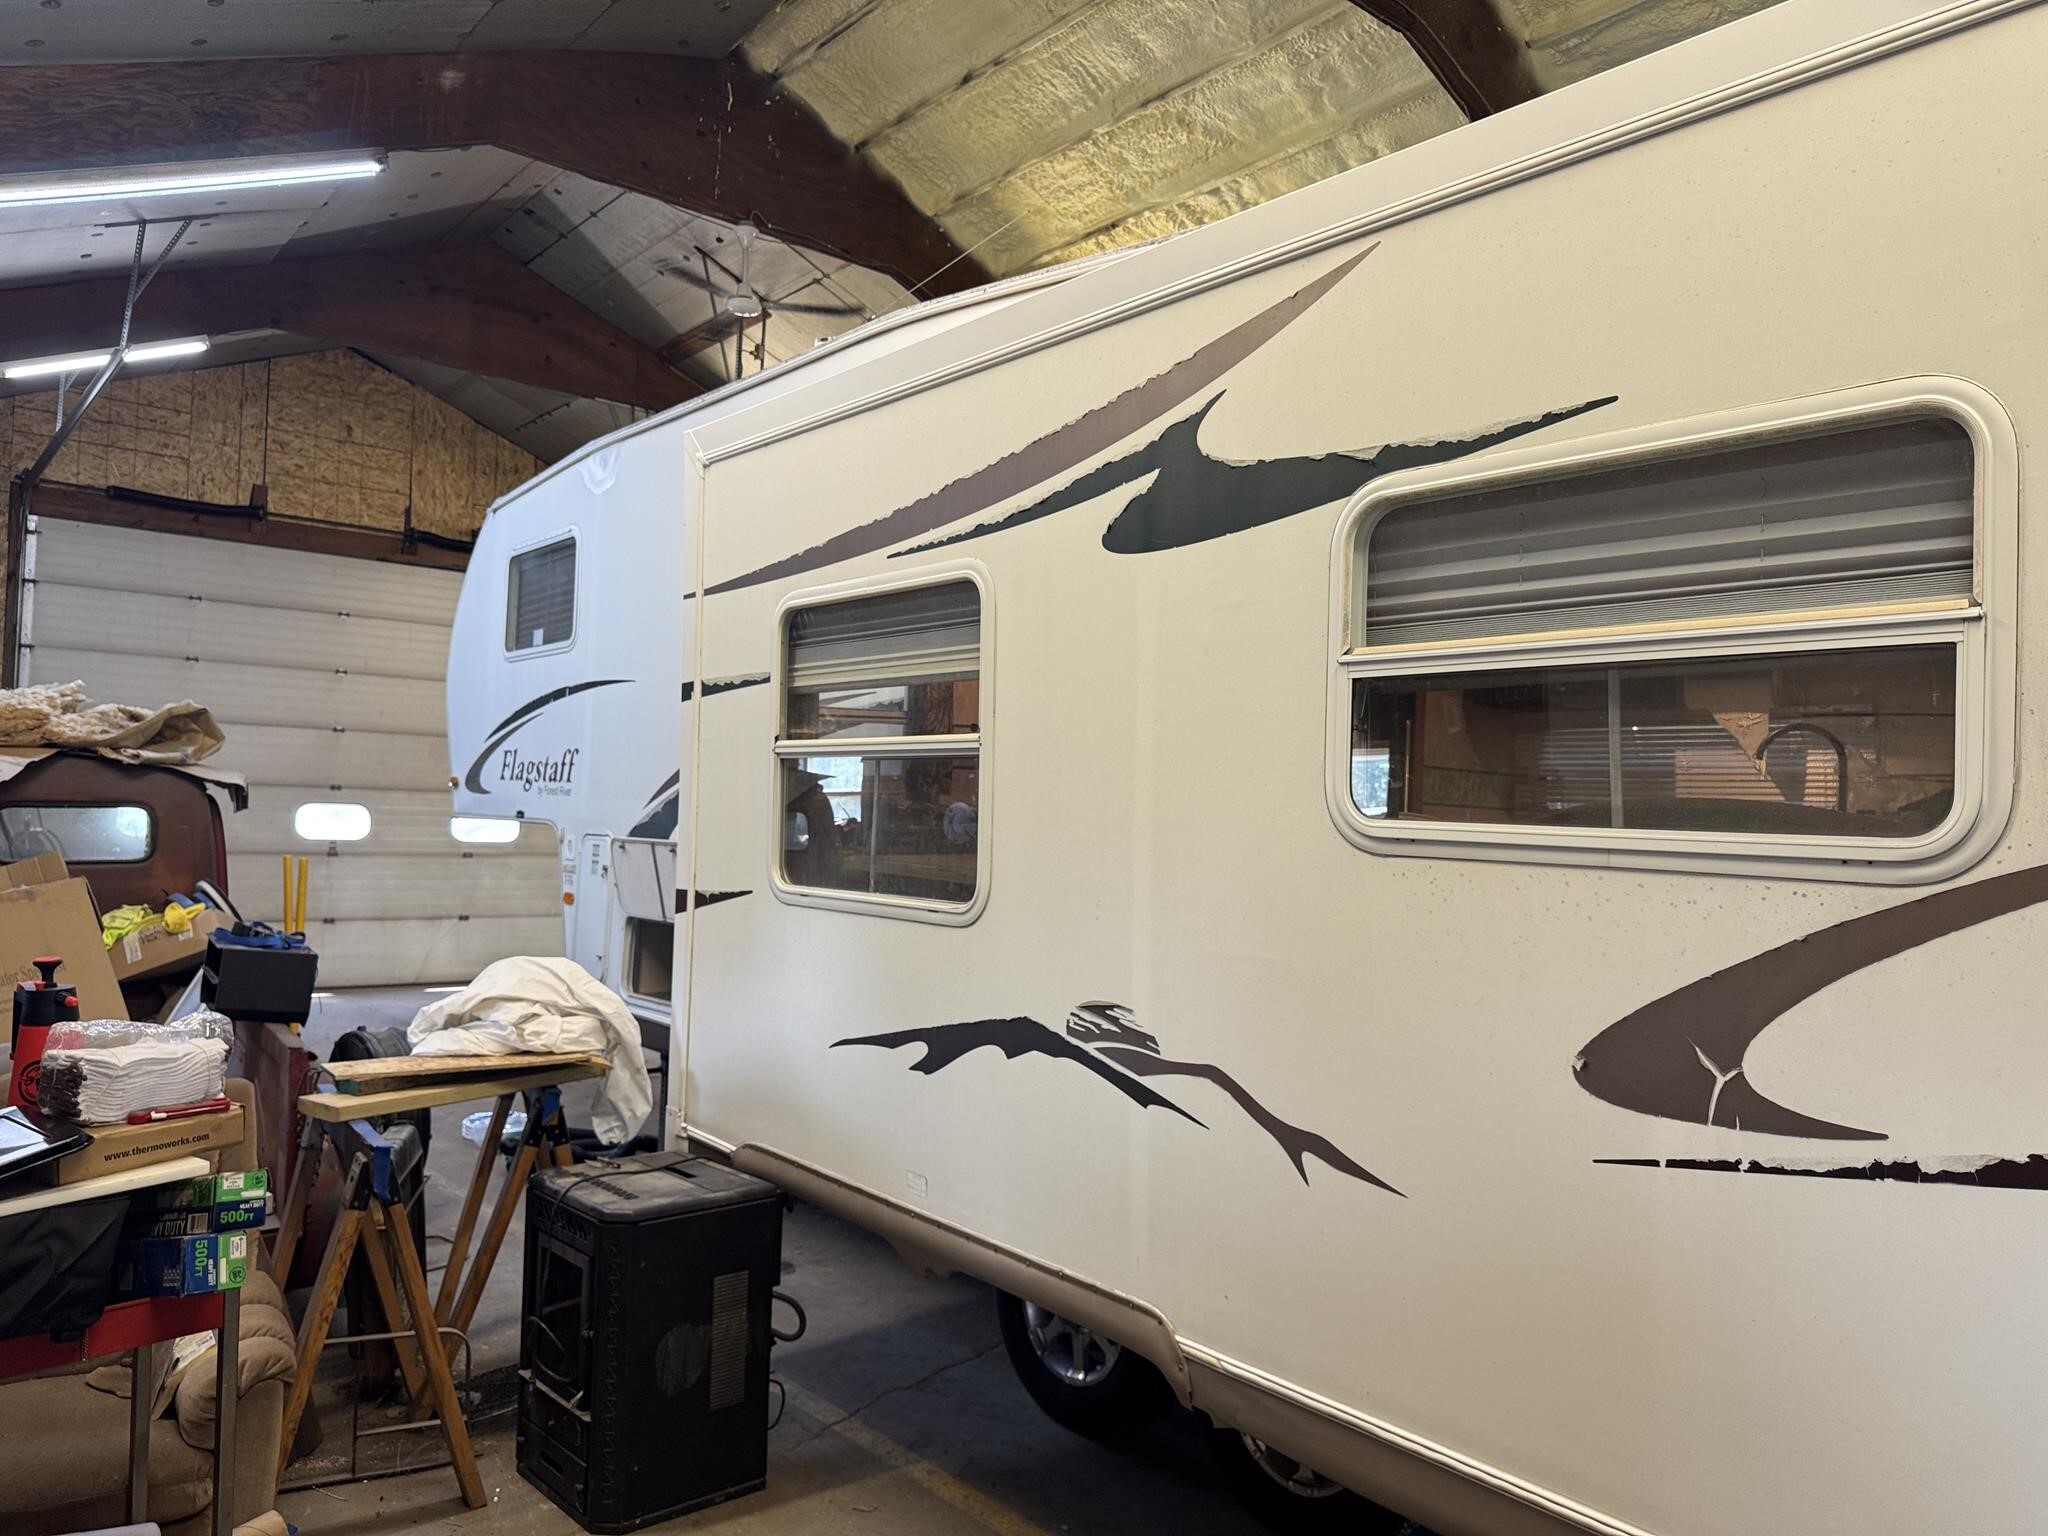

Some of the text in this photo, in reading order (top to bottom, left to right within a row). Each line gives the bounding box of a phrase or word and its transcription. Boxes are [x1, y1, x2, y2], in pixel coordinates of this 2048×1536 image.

[500, 747, 579, 792] Flagstaff
[103, 1133, 210, 1162] www.thermoworks.com
[165, 1219, 186, 1236] DUTY
